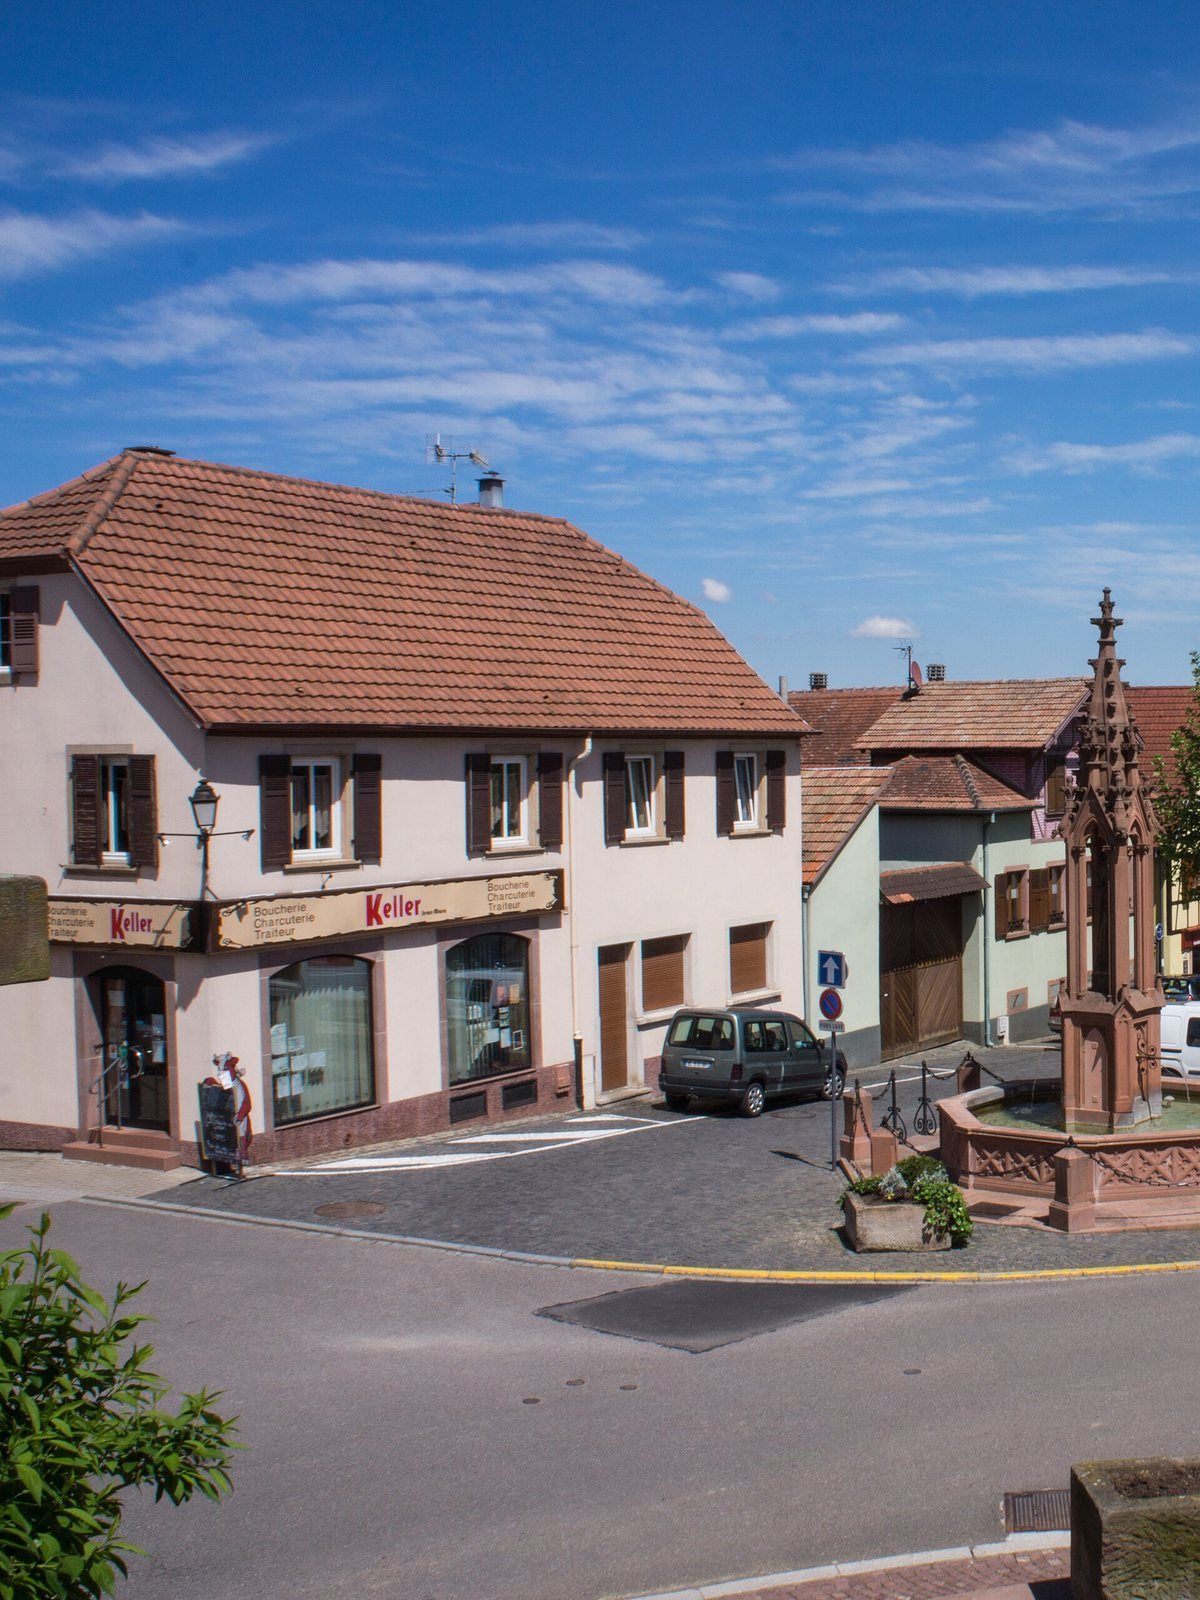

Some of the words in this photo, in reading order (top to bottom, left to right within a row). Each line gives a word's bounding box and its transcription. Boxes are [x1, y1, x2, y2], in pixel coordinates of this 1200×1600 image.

[487, 880, 530, 892] Boucherie
[487, 889, 536, 902] Charcuterie
[49, 906, 88, 917] oucherie
[254, 902, 307, 917] Boucherie
[366, 893, 422, 927] Keller
[488, 900, 521, 911] Traiteur
[49, 916, 95, 928] harcuterie
[111, 908, 153, 940] Keller
[253, 912, 316, 929] Charcuterie
[50, 927, 78, 938] raiteur
[255, 927, 296, 940] Traiteur
